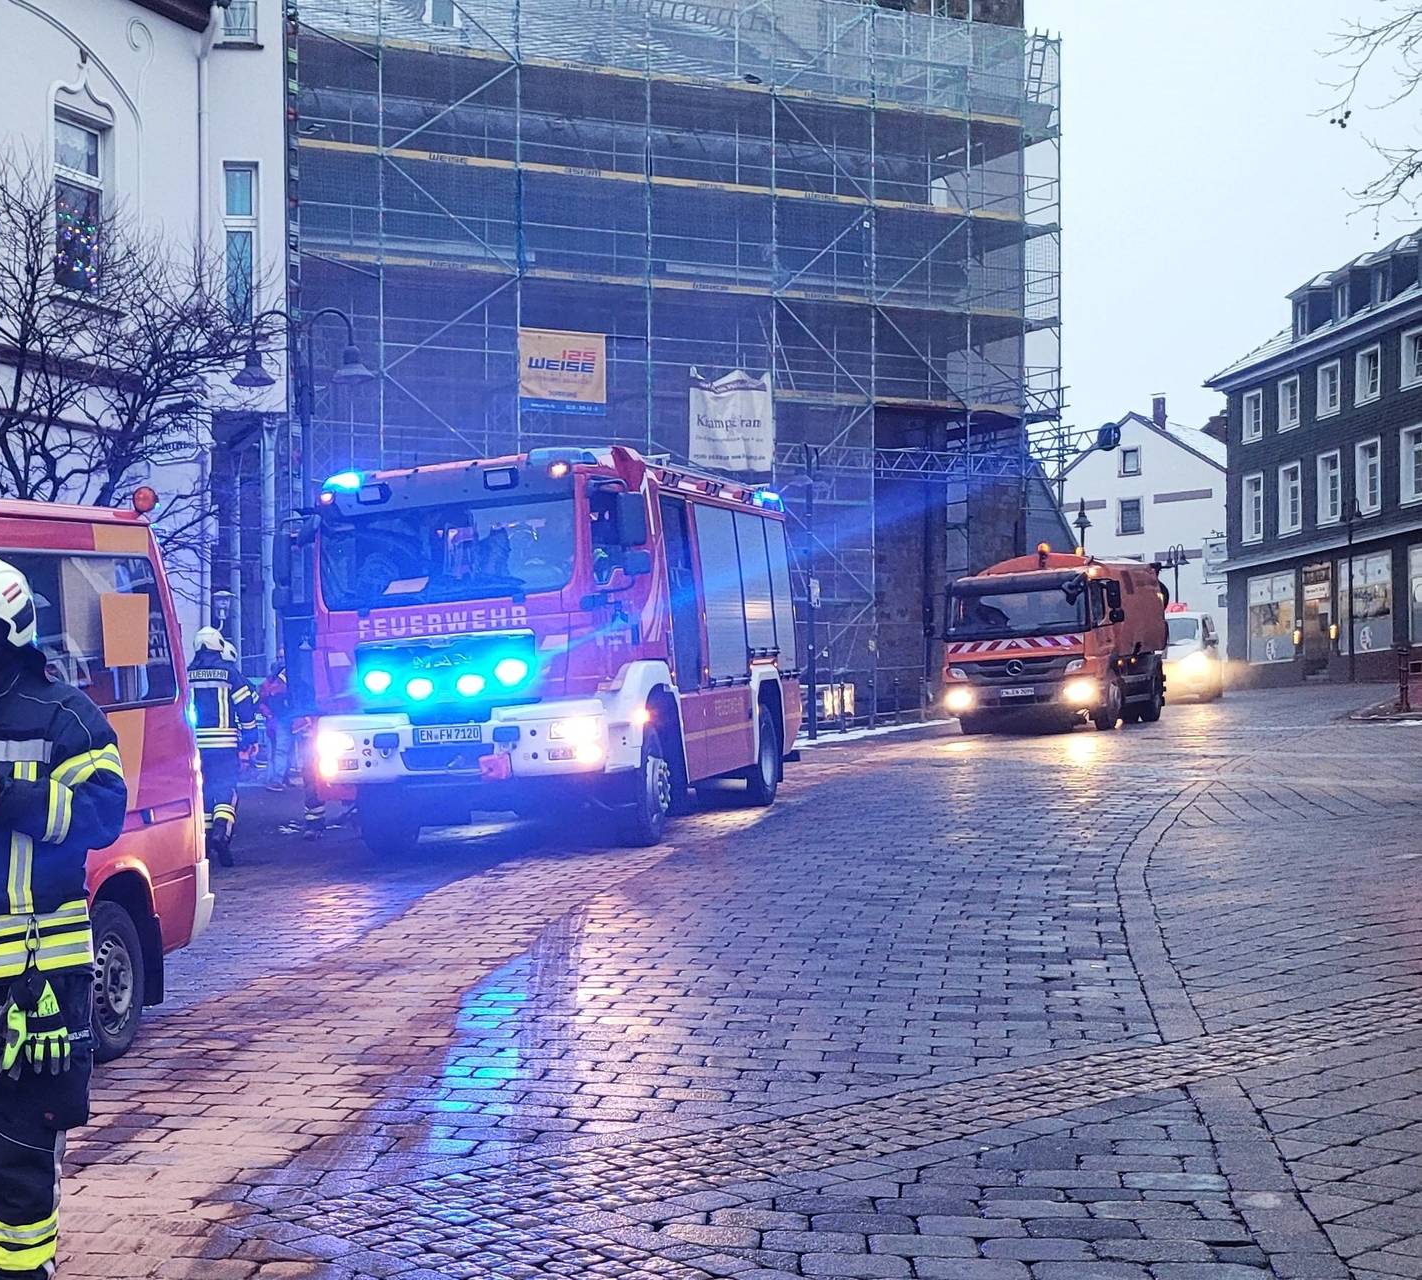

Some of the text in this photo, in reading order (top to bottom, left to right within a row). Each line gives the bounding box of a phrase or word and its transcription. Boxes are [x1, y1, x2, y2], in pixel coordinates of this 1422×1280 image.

[527, 356, 595, 373] WEISE
[358, 606, 527, 640] FEUERWEHR
[420, 730, 433, 741] EN
[454, 727, 479, 740] 7120
